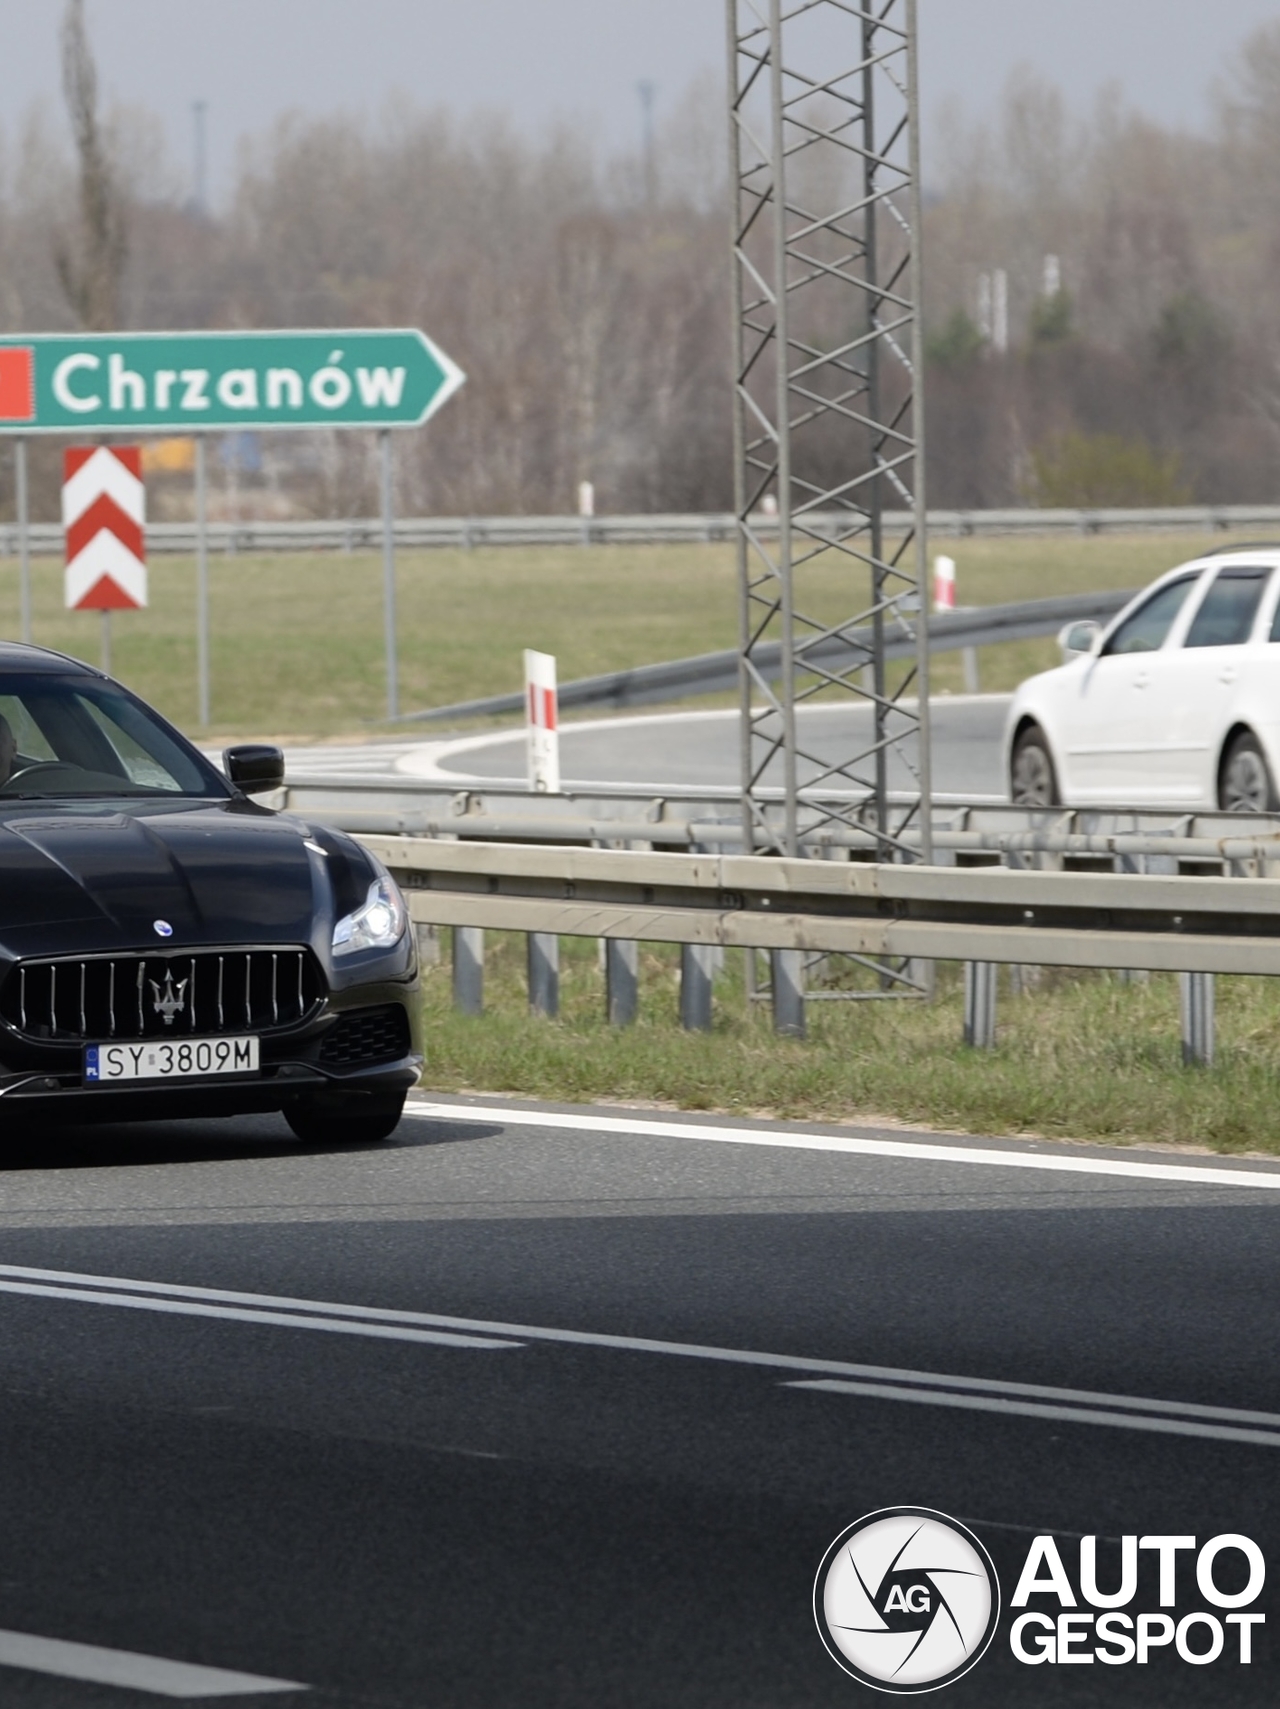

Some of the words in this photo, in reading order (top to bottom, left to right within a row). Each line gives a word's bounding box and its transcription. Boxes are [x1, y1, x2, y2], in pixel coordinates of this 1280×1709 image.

[52, 350, 406, 413] Chrzanów
[86, 1067, 98, 1076] PL
[107, 1046, 144, 1077] SY
[158, 1039, 251, 1074] 3809M
